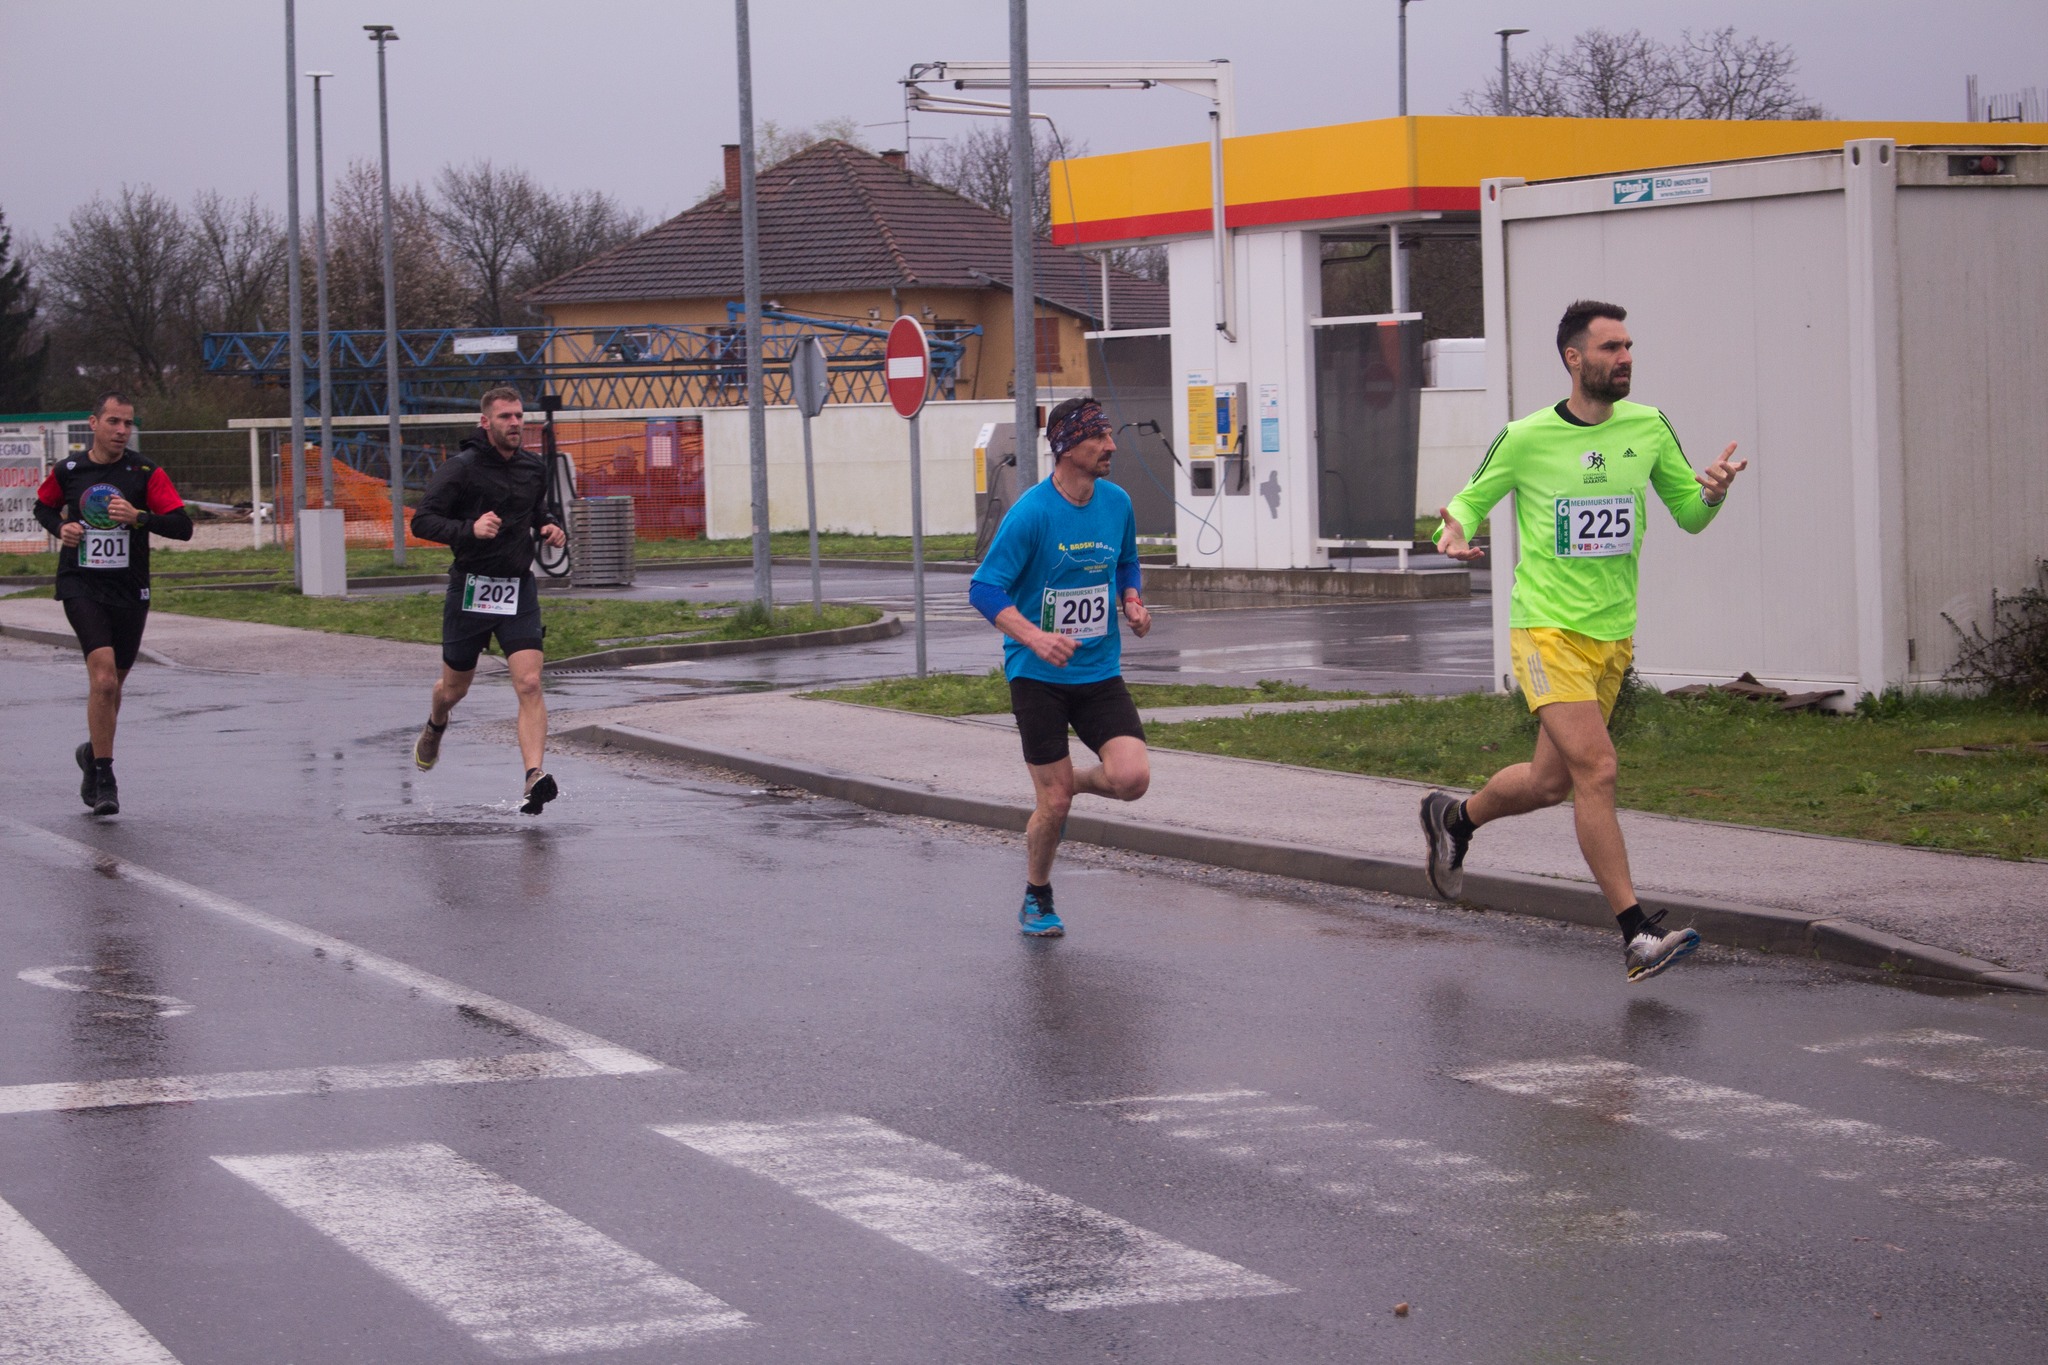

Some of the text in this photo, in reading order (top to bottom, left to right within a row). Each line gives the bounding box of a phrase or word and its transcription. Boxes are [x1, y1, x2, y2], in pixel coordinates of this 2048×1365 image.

[1615, 180, 1650, 194] Tehnix
[1655, 178, 1673, 189] EKO
[1615, 497, 1633, 505] TRIAL
[1578, 508, 1631, 540] 225
[91, 538, 126, 557] 201
[479, 584, 515, 604] 202
[1062, 596, 1105, 625] 203
